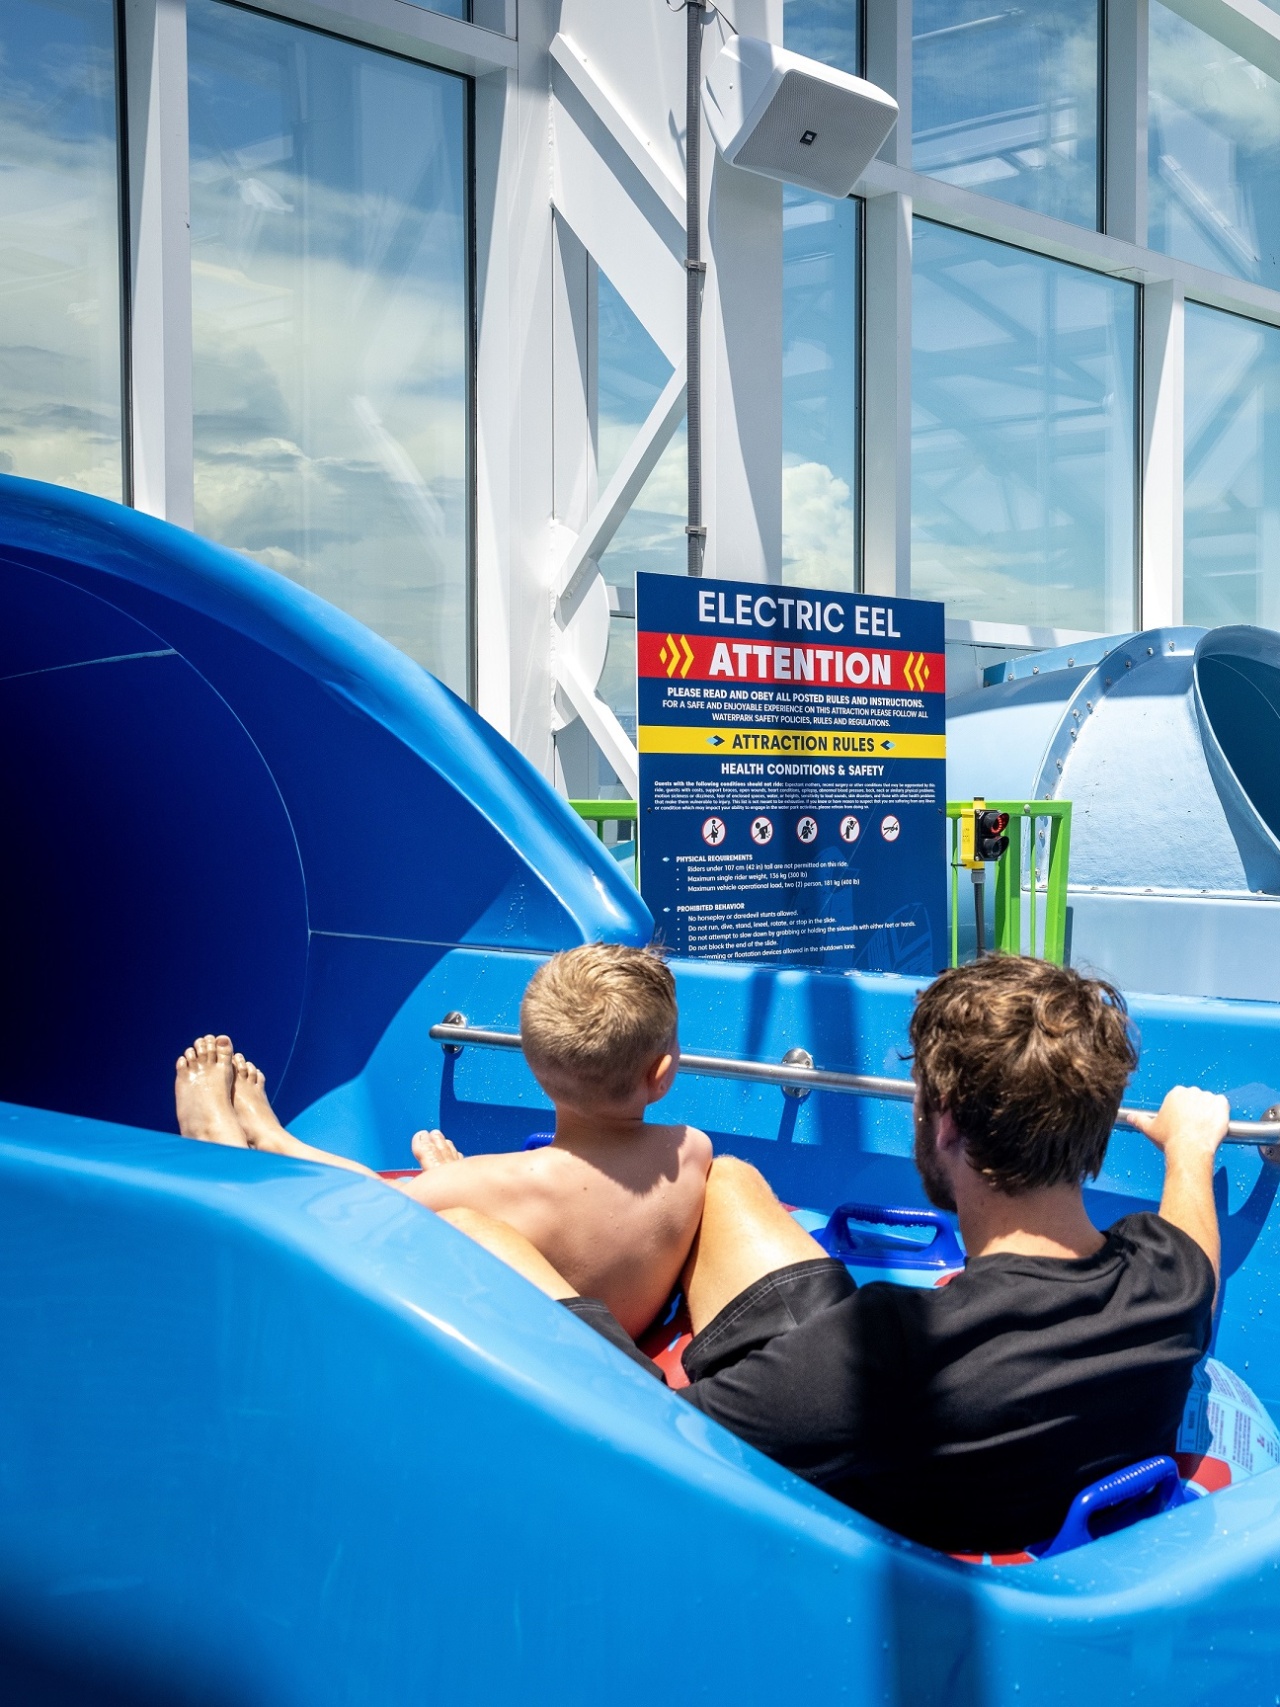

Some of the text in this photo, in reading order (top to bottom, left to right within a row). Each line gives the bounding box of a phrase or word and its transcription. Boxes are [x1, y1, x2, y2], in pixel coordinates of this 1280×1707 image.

[698, 591, 900, 638] ELECTRIC EEL
[709, 643, 891, 686] ATTENTION
[667, 687, 923, 708] PLEASE READ AND OBEY ALL POSTED RULES AND INSTRUCTIONS.
[662, 700, 927, 718] FOR A SAFE AND ENJOYABLE EXPERIENCE ON THIS ATTRACTION PLEASE FOLLOW ALL
[712, 713, 753, 723] WATERPARK
[754, 714, 778, 723] SAFETY
[813, 716, 832, 725] RULES
[833, 717, 847, 726] AND
[732, 735, 874, 752] ATTRACTION RULES
[721, 764, 883, 776] HEALTH CONDITIONS & SAFETY
[707, 854, 752, 862] REQUIREMENTS
[687, 874, 715, 882] Maximum
[716, 874, 733, 883] single
[734, 873, 747, 881] rider
[779, 872, 786, 881] kg
[787, 872, 799, 881] (300
[676, 903, 744, 912] PROHIBITED BEHAVIOR
[697, 914, 724, 923] horseplay
[796, 919, 807, 927] stop
[708, 933, 731, 942] attempt
[767, 930, 774, 938] by
[775, 929, 799, 938] grabbing
[807, 927, 826, 936] holding
